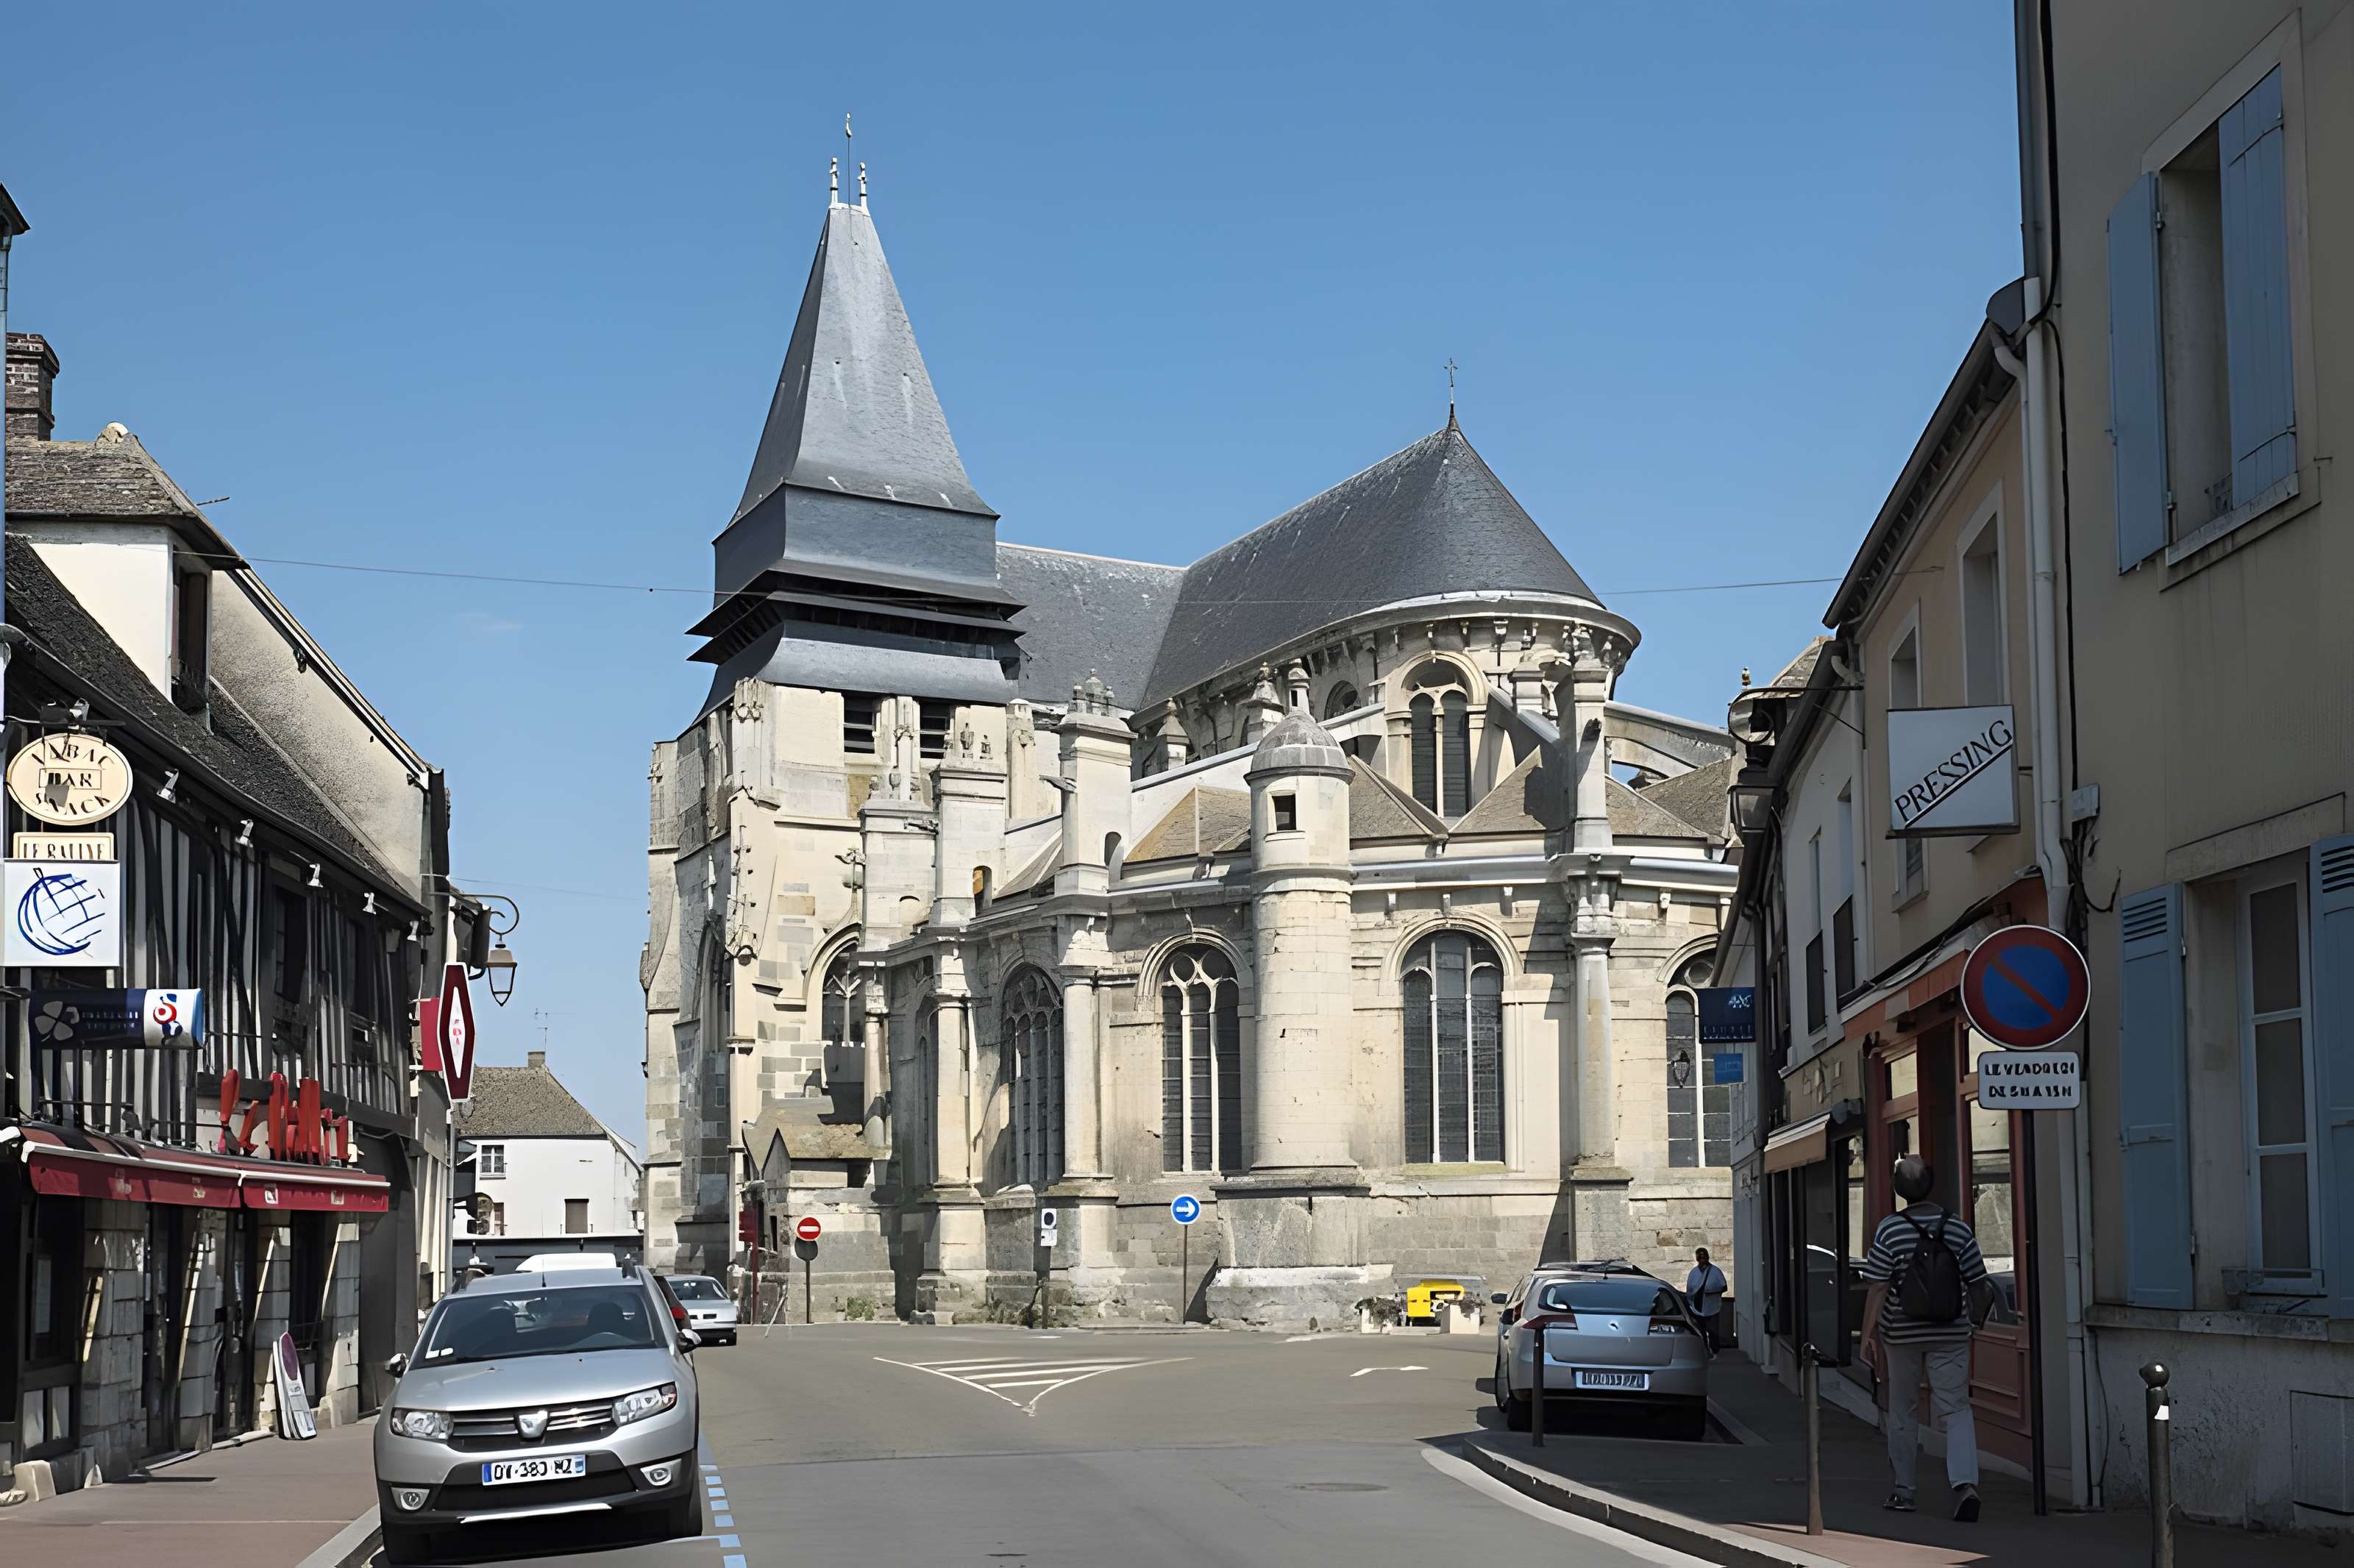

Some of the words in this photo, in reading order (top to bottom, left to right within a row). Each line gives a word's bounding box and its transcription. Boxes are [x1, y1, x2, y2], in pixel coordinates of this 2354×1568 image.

[30, 742, 114, 765] TABAC
[48, 773, 91, 788] BAR
[1895, 720, 2012, 822] PRESSING
[35, 792, 110, 816] SNACK
